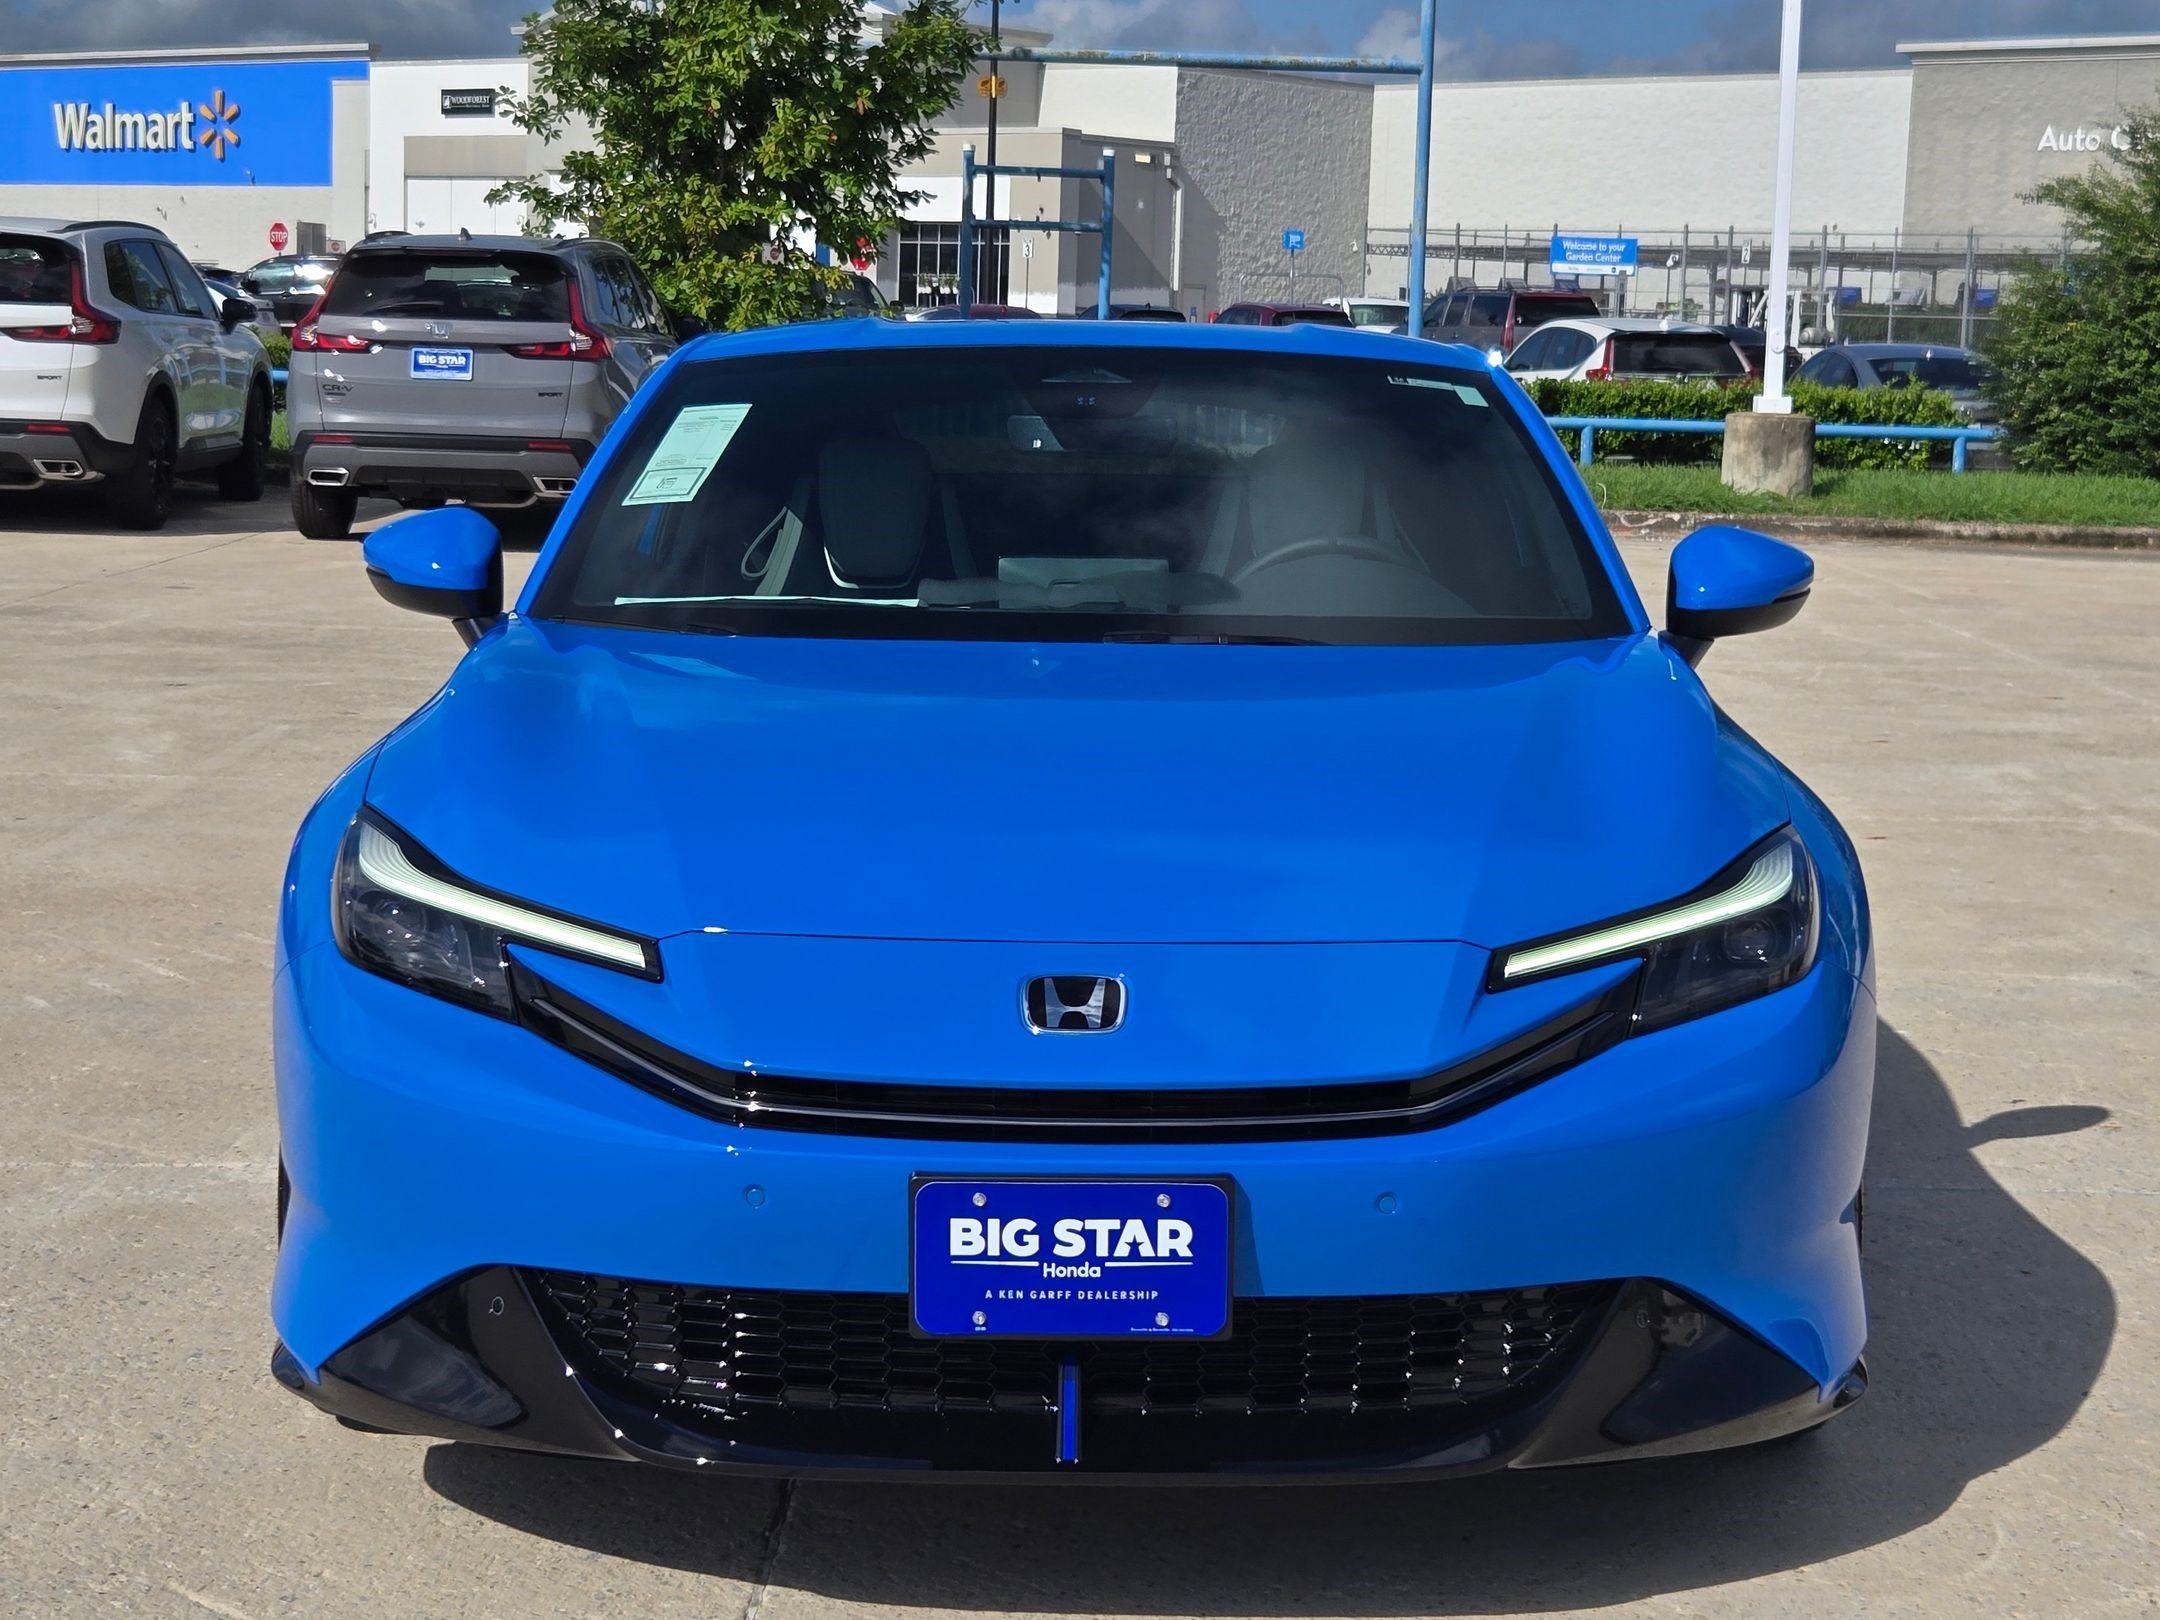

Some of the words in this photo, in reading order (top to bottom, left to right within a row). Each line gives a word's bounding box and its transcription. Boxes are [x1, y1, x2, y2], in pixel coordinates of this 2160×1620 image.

[53, 102, 194, 151] Walmart
[2037, 124, 2101, 152] Auto
[271, 232, 287, 243] STOP
[1024, 244, 1031, 257] 3
[1562, 240, 1597, 251] Welcome
[1599, 241, 1608, 252] to
[1609, 244, 1626, 252] your
[1565, 252, 1593, 261] Garden
[1595, 252, 1621, 262] Center
[1743, 247, 1749, 263] 2
[418, 355, 437, 364] BIG
[438, 355, 466, 365] STAR
[949, 1218, 1040, 1257] BIG
[1052, 1218, 1194, 1258] STAR
[1042, 1262, 1102, 1279] Honda
[985, 1289, 993, 1300] A
[998, 1290, 1025, 1300] KEN
[1029, 1290, 1072, 1300] GARFF
[1077, 1290, 1160, 1301] DEALERSHIP
